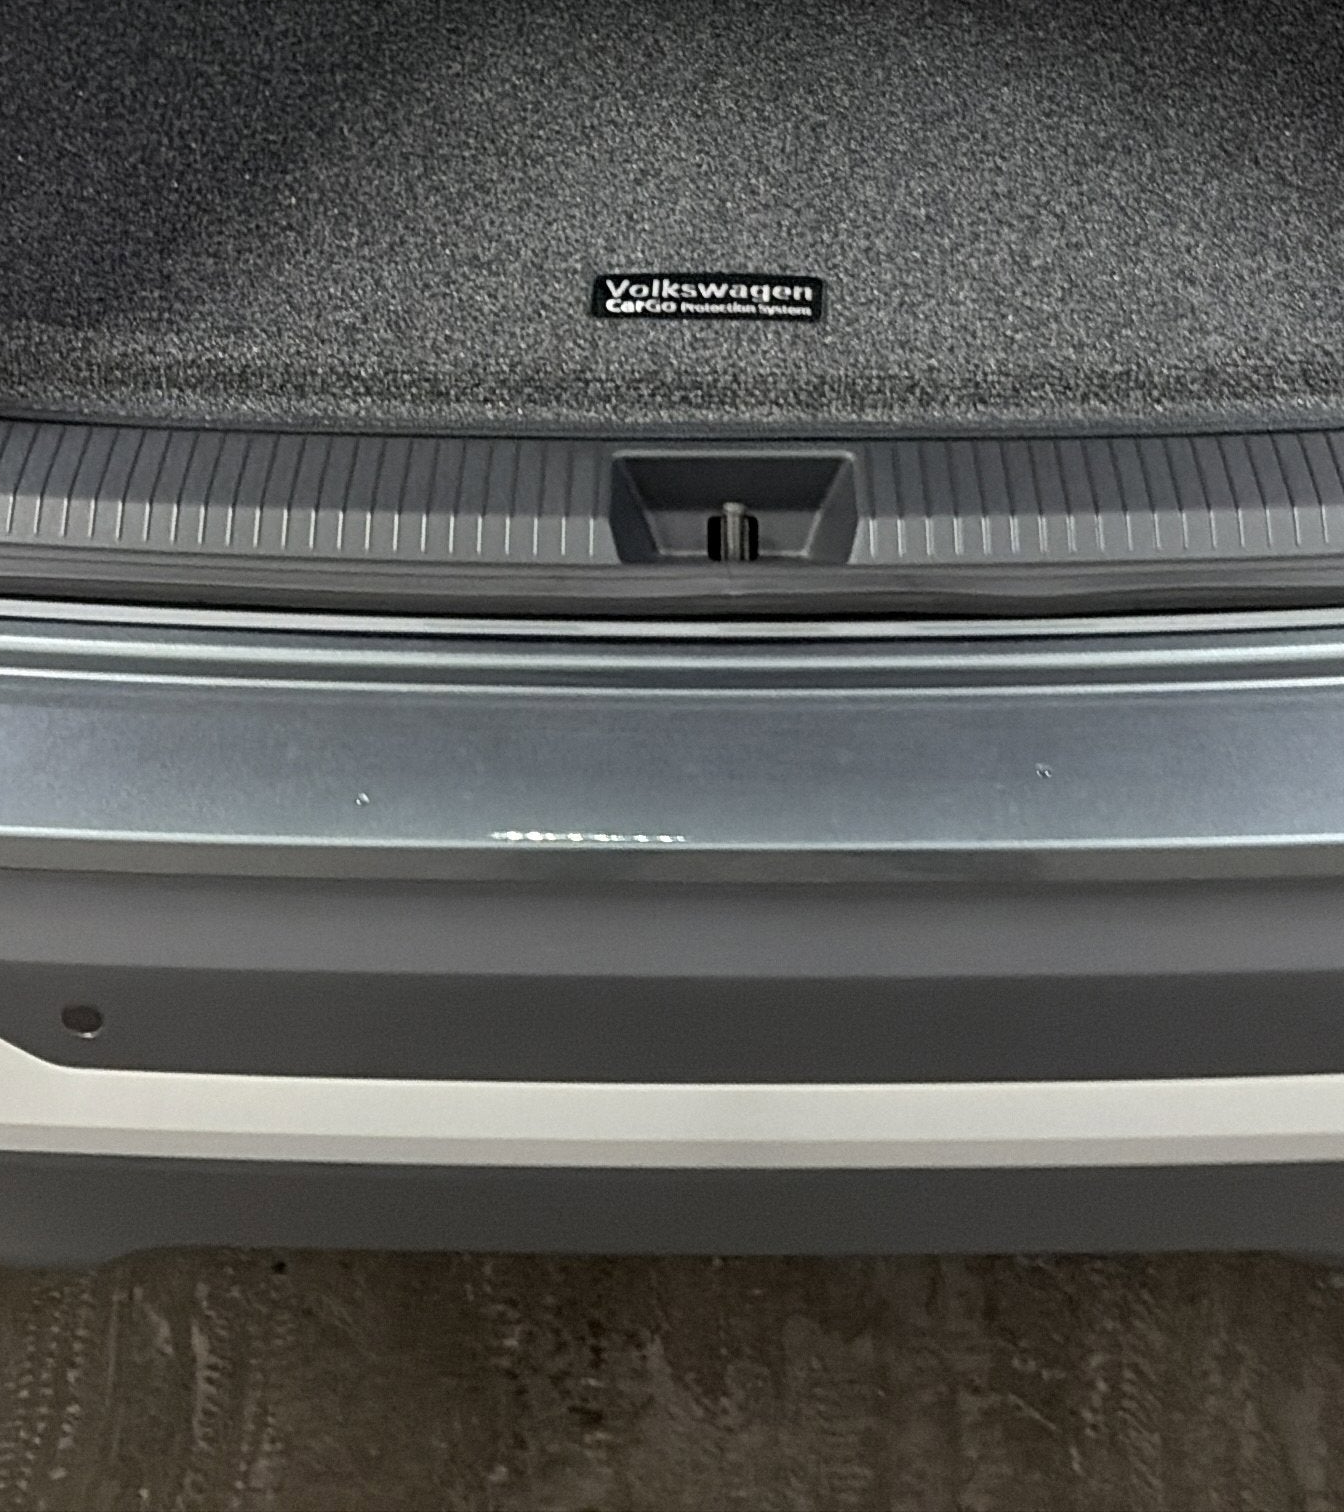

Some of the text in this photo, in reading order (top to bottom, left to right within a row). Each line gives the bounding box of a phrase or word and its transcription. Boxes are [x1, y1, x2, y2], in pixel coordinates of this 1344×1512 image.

[605, 278, 813, 303] Volkswagen
[680, 301, 756, 314] Protection
[758, 303, 813, 317] System
